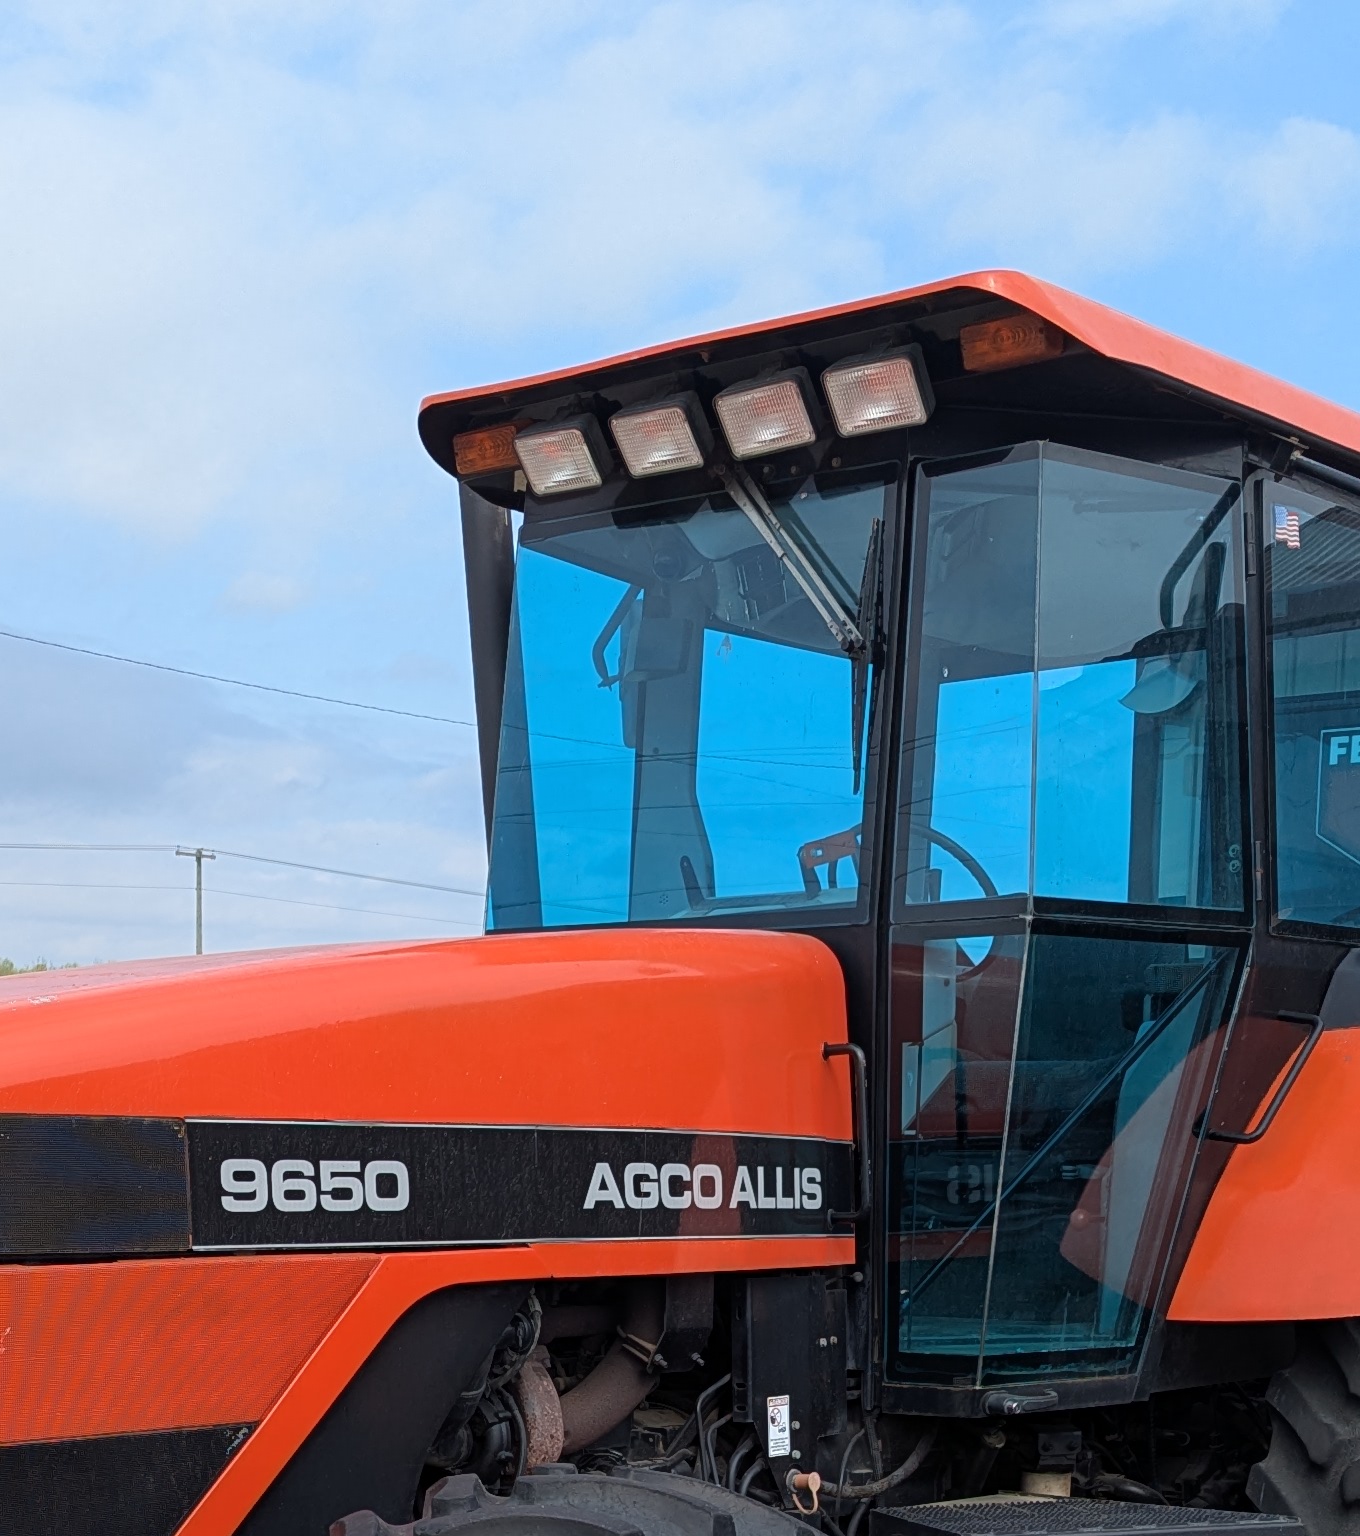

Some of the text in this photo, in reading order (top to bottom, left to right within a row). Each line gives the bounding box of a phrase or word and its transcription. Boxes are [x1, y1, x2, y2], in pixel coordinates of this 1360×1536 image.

[221, 1159, 409, 1212] 9650
[583, 1162, 822, 1211] AGCO ALLIS
